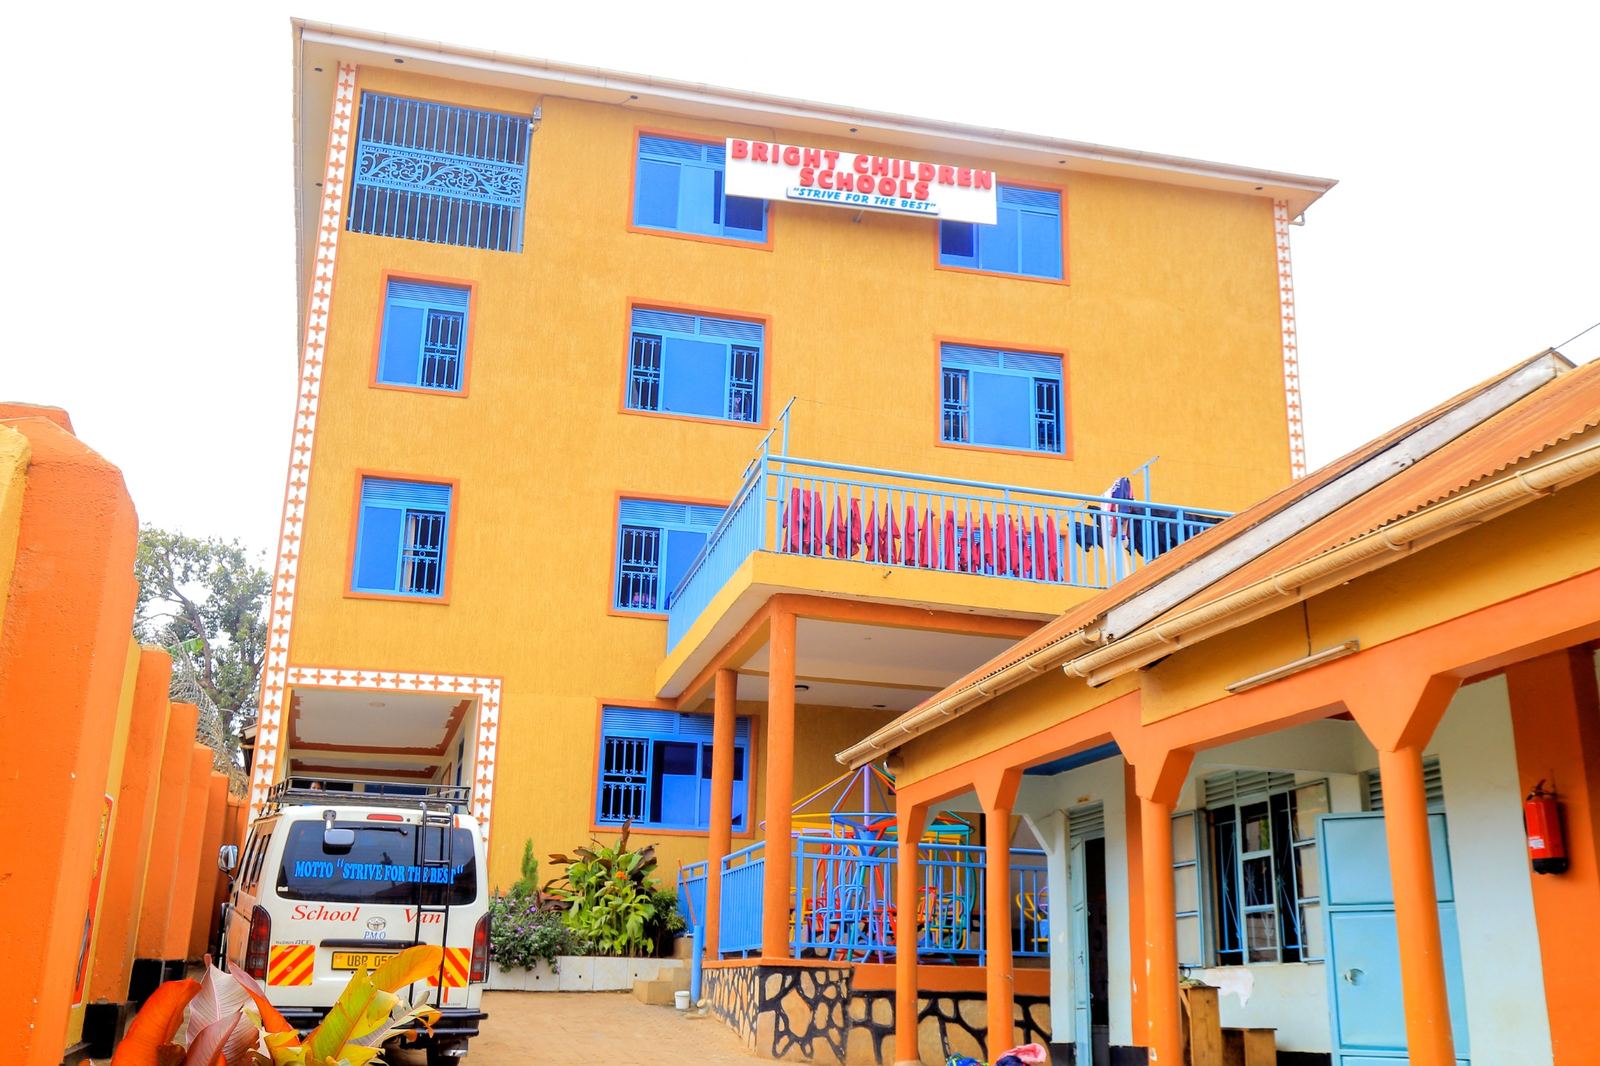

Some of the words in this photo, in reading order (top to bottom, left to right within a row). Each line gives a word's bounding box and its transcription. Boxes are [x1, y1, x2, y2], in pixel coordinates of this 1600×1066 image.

[731, 139, 839, 170] BRIGHT
[853, 154, 992, 191] CHILDREN
[799, 167, 930, 201] SCHOOLS
[845, 193, 869, 204] FOR
[873, 196, 896, 208] THE
[294, 861, 334, 878] MOTTO
[384, 864, 406, 882] FOR
[407, 866, 429, 883] THE
[291, 904, 361, 923] School
